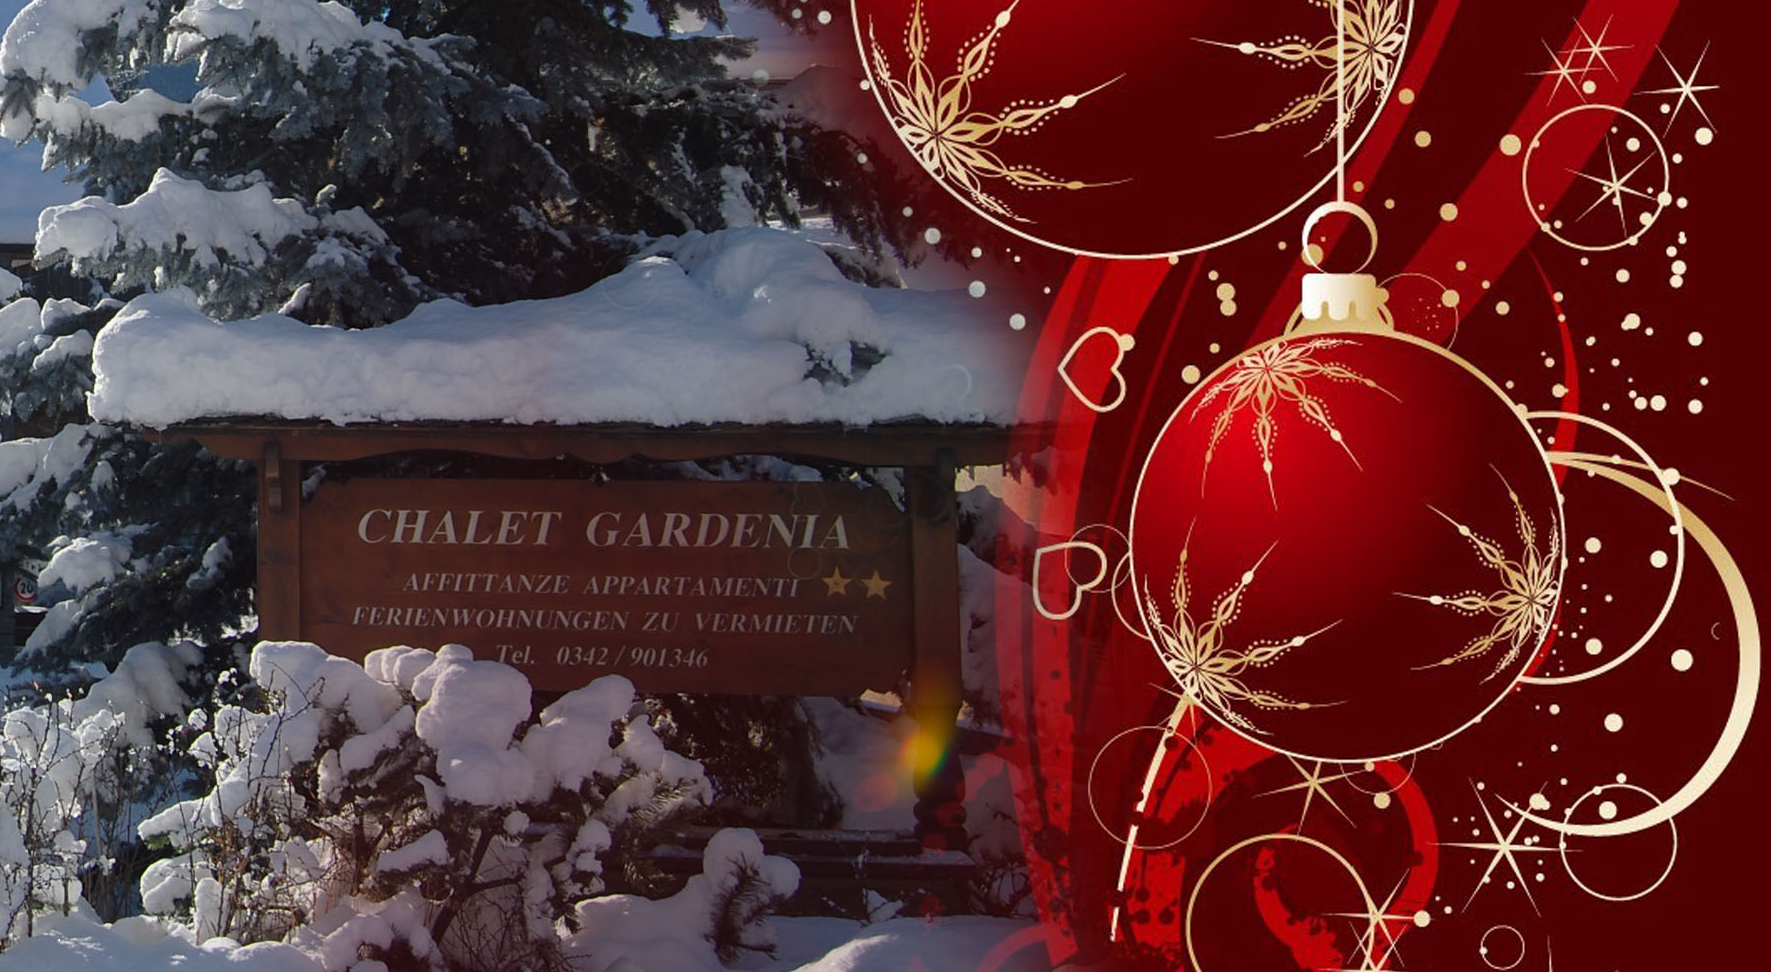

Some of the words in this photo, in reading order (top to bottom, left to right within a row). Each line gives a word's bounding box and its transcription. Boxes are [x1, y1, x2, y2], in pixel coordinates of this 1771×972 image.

[358, 509, 562, 546] CHALET
[586, 512, 850, 549] GARDENIA
[402, 573, 570, 594] AFFITTANZE
[582, 576, 800, 597] APPARTAMENTI
[353, 606, 630, 630] FERIENWOHNUNGEN
[642, 612, 679, 632] ZU
[696, 613, 858, 634] VERMIETEN
[496, 645, 535, 665] Tel.
